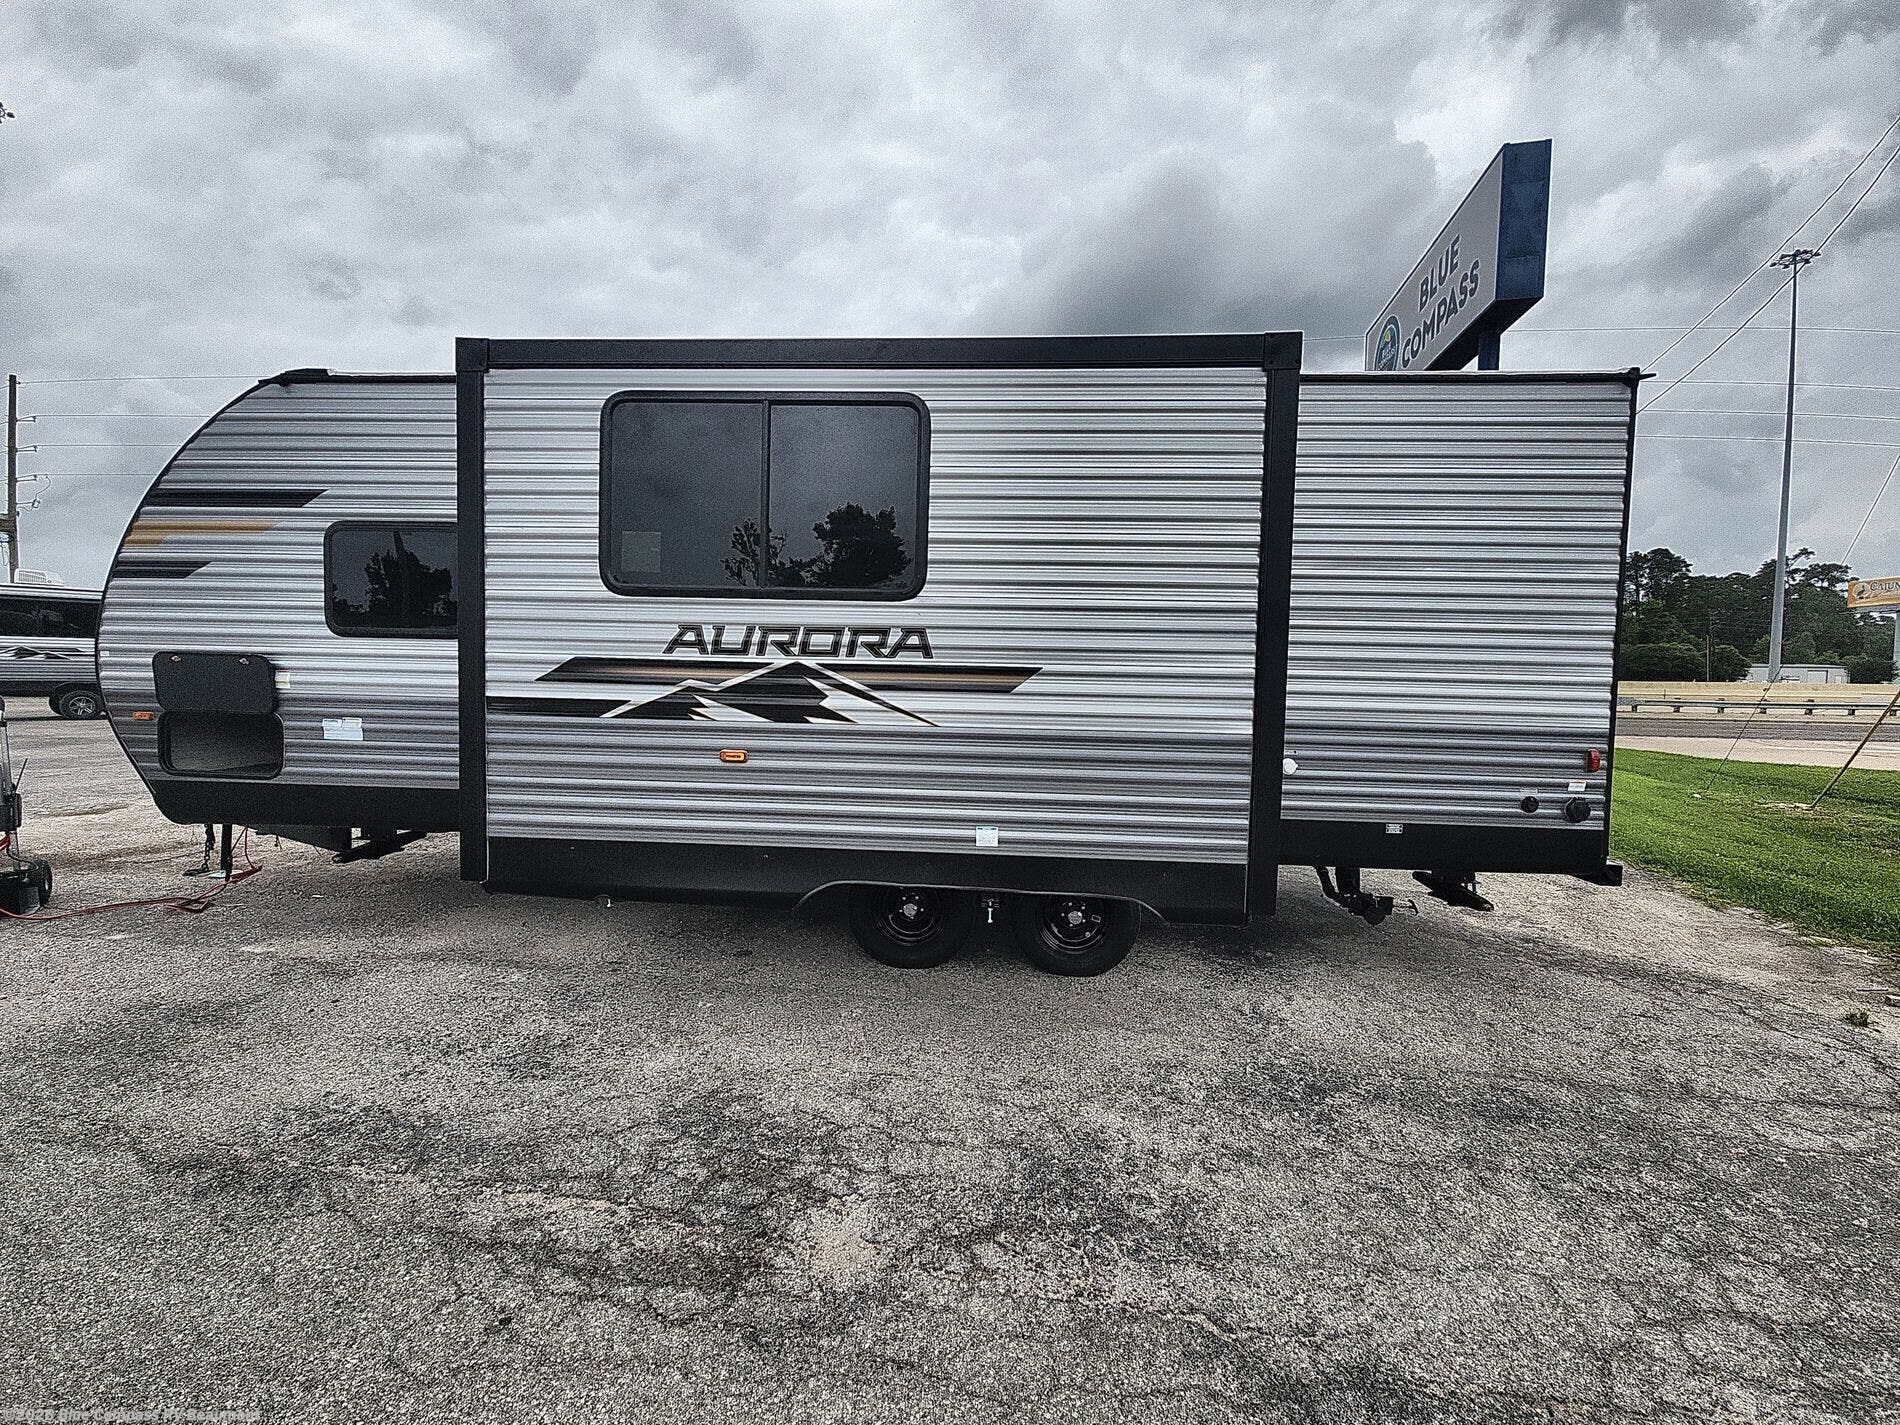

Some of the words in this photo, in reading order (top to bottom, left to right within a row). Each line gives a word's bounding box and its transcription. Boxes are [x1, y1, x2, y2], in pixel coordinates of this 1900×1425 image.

[1418, 234, 1461, 312] BLUE
[1402, 259, 1480, 369] COMPASS
[662, 624, 934, 659] AURORA
